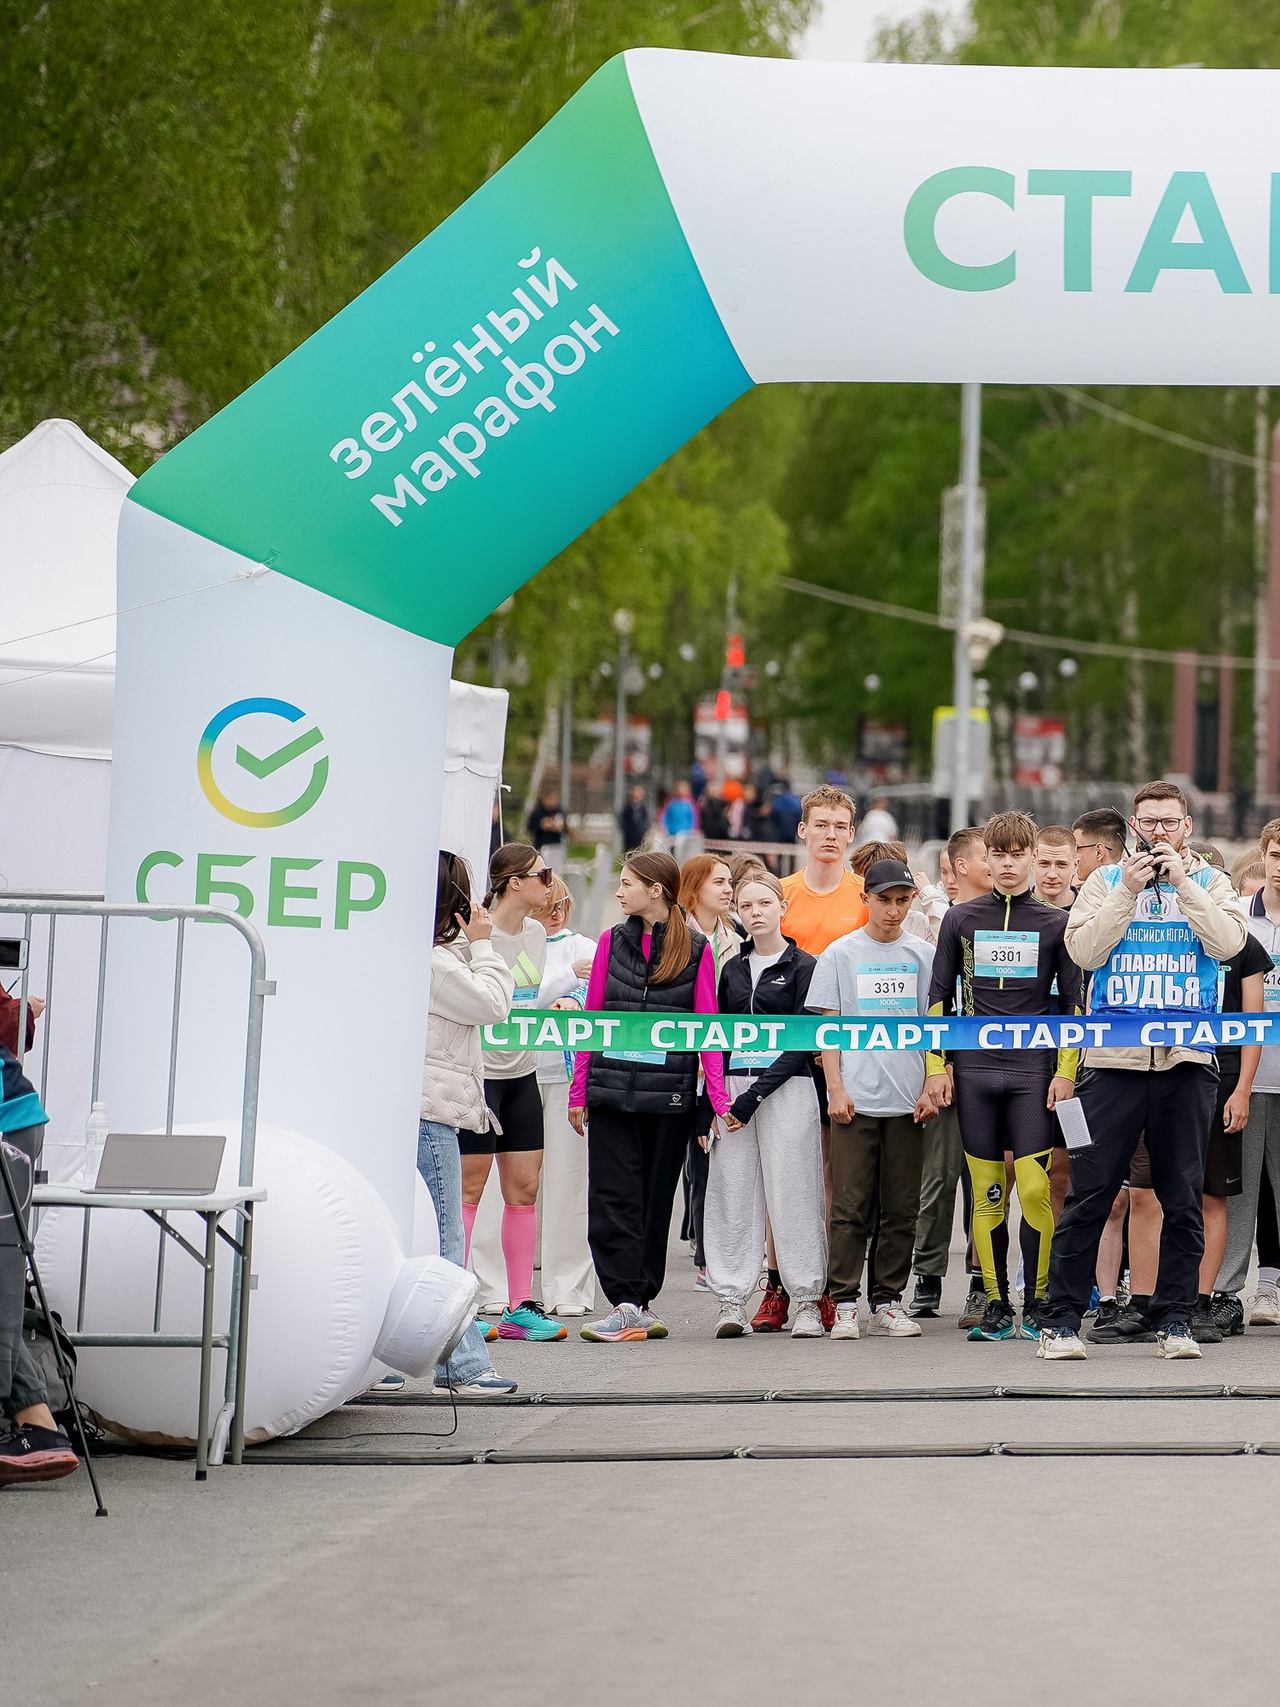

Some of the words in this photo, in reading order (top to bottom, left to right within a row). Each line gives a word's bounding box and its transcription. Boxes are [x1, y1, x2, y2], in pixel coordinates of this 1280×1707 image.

[329, 246, 578, 480] зелёный
[369, 303, 621, 528] марафон
[136, 850, 387, 931] СБЕР
[1166, 928, 1190, 943] ЮГРА
[991, 950, 1021, 962] 3301
[1111, 951, 1197, 974] ГЛАВНЫЙ
[874, 982, 905, 994] 3319
[1107, 974, 1200, 1009] СУДЬЯ
[484, 1016, 620, 1047] СТАРТ
[650, 1019, 786, 1049] СТАРТ
[815, 1023, 949, 1050] СТАРТ
[978, 1022, 1111, 1048] СТАРТ
[1140, 1019, 1274, 1046] СТАРТ
